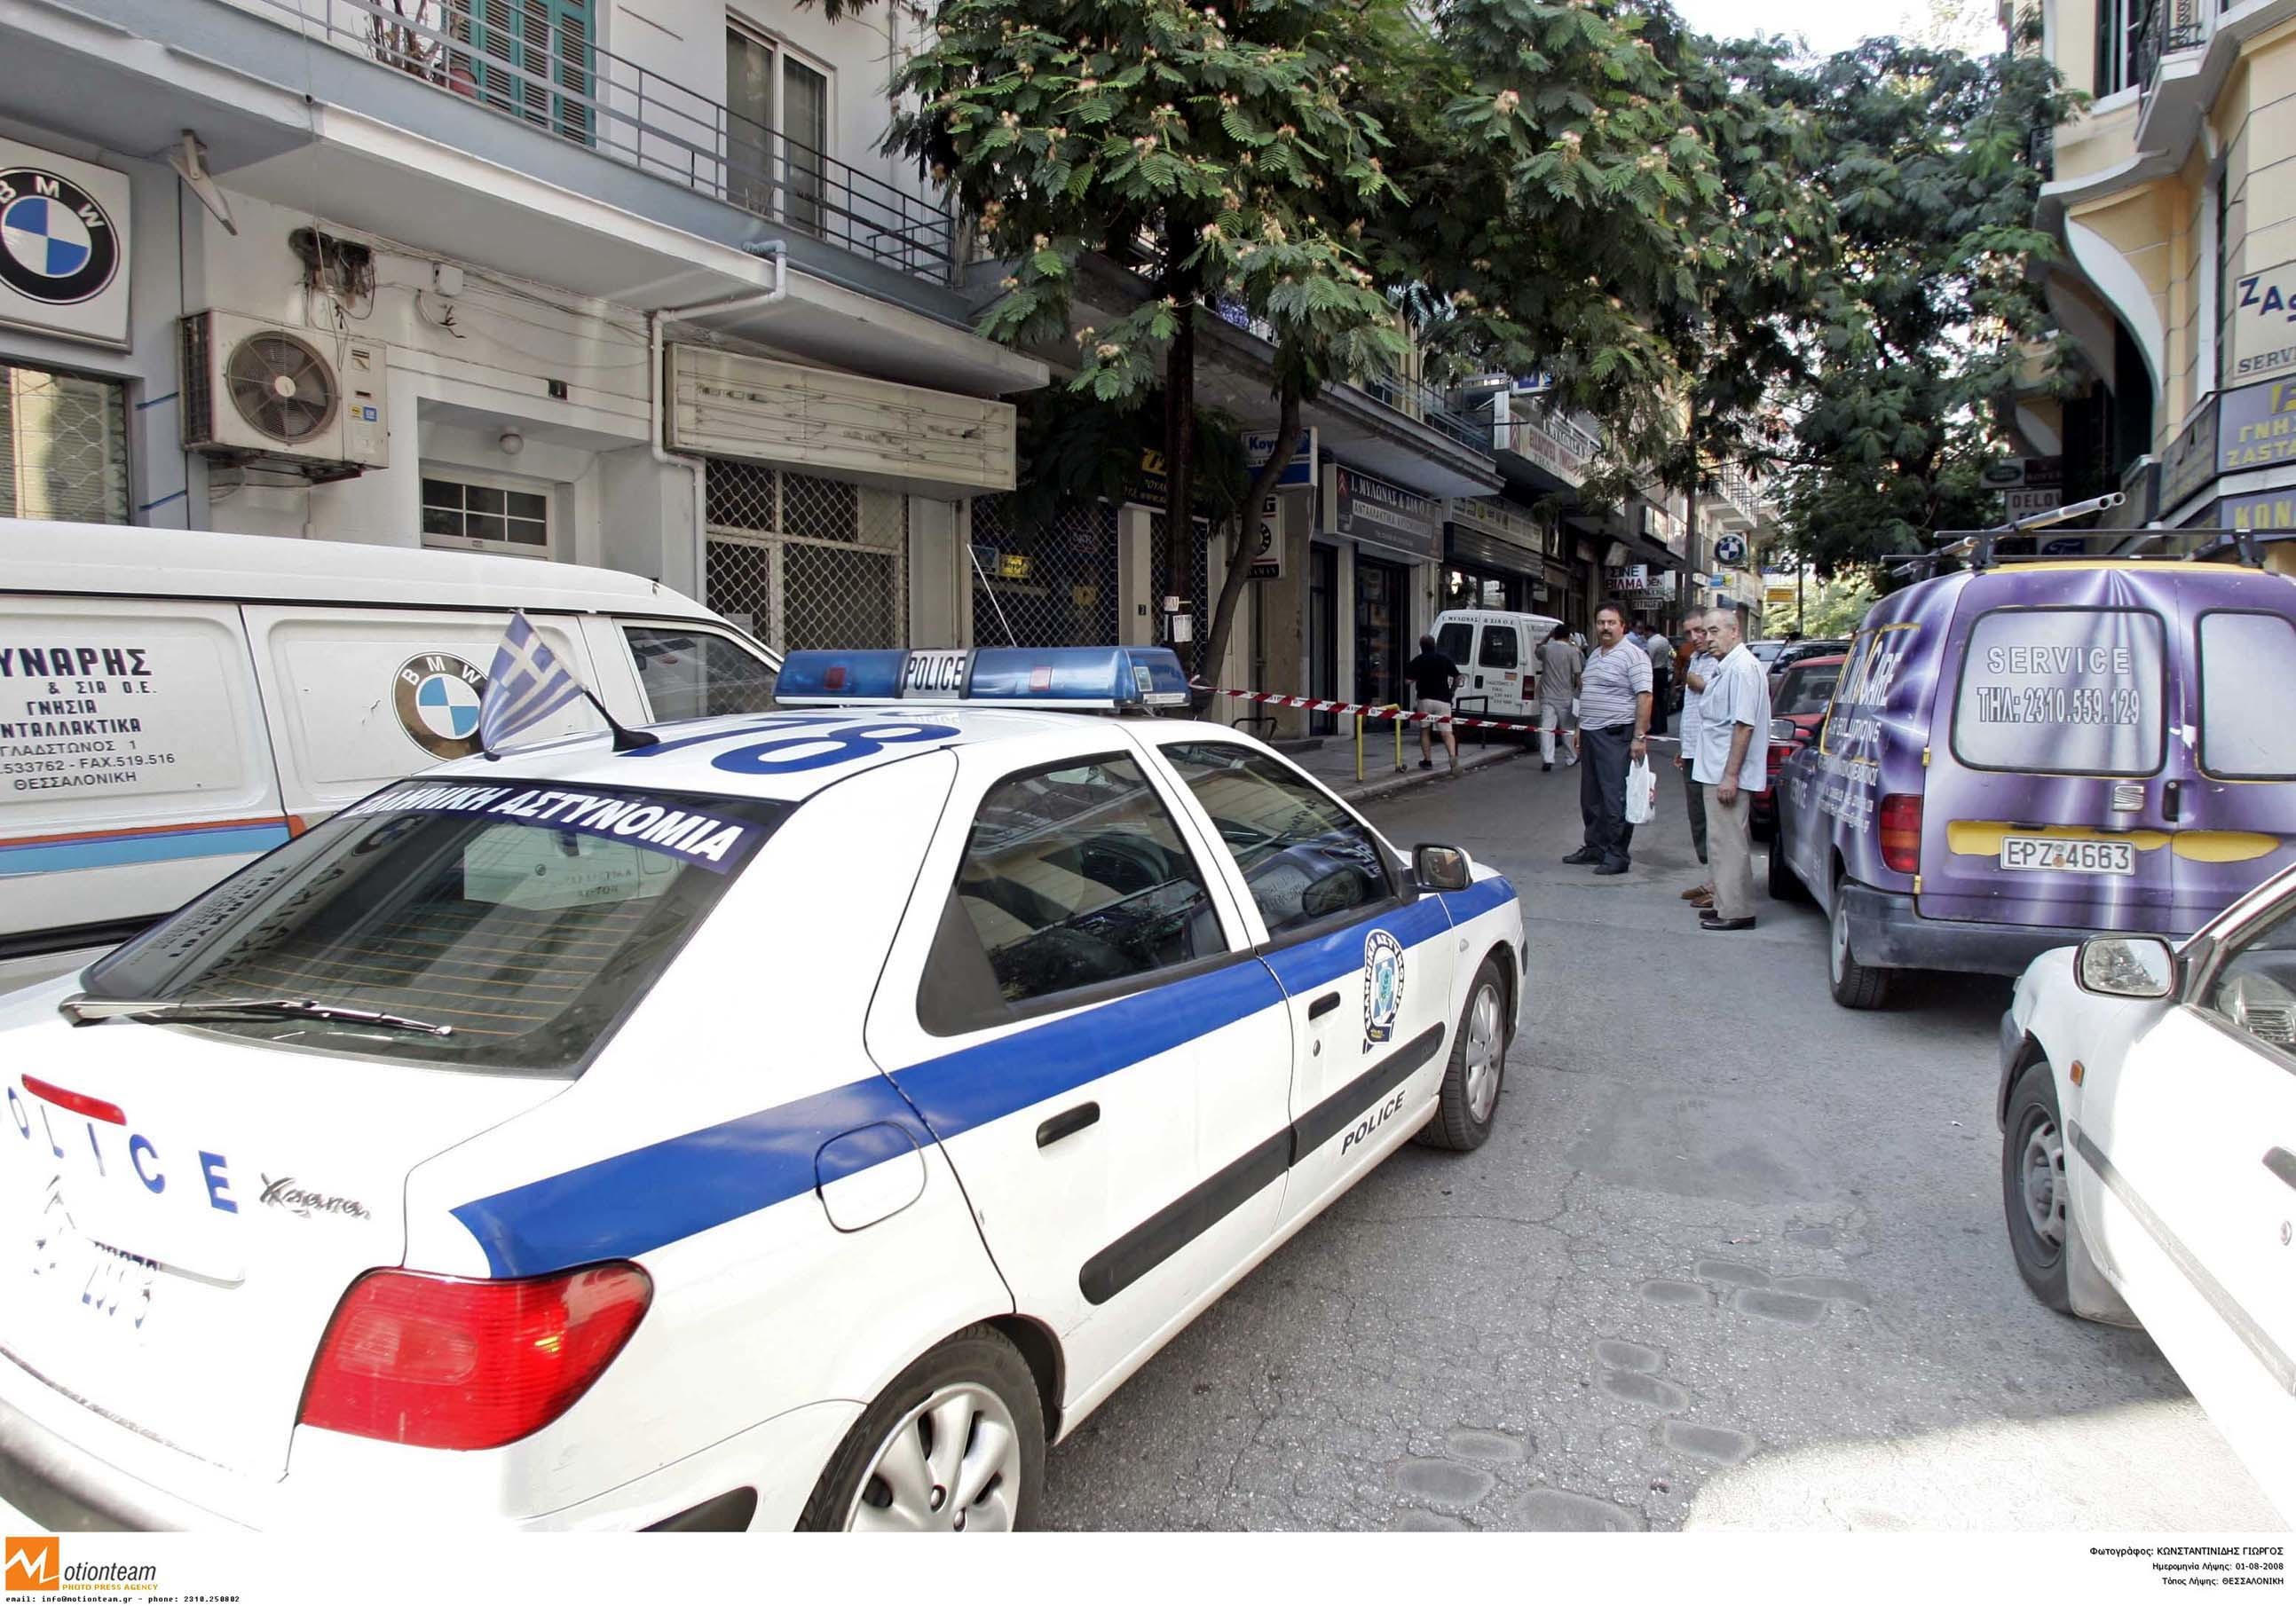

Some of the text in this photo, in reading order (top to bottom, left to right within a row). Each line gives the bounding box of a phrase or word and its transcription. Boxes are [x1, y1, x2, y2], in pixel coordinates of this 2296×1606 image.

[0, 176, 107, 228] BMW
[402, 655, 482, 686] BMW
[903, 656, 966, 690] POLICE
[1987, 646, 2131, 674] SERVICE
[48, 681, 60, 695] &
[76, 681, 107, 694] ΣΙΑ
[27, 699, 98, 716] ΓΝΗΣΙΑ
[2023, 687, 2140, 724] 2310.559.129
[0, 740, 137, 757] ΓΛΑΔΣΤΩΝΟΣ 1
[80, 753, 175, 770] FAX.519.516
[13, 771, 137, 791] ΘΕΣΣΑΛΟΝΙΚΗ
[488, 789, 746, 862] ΑΣΤΥΝΟΜΙΑ
[2066, 844, 2129, 870] 4663
[1341, 1090, 1405, 1156] POLICE
[0, 1085, 239, 1214] OLICE
